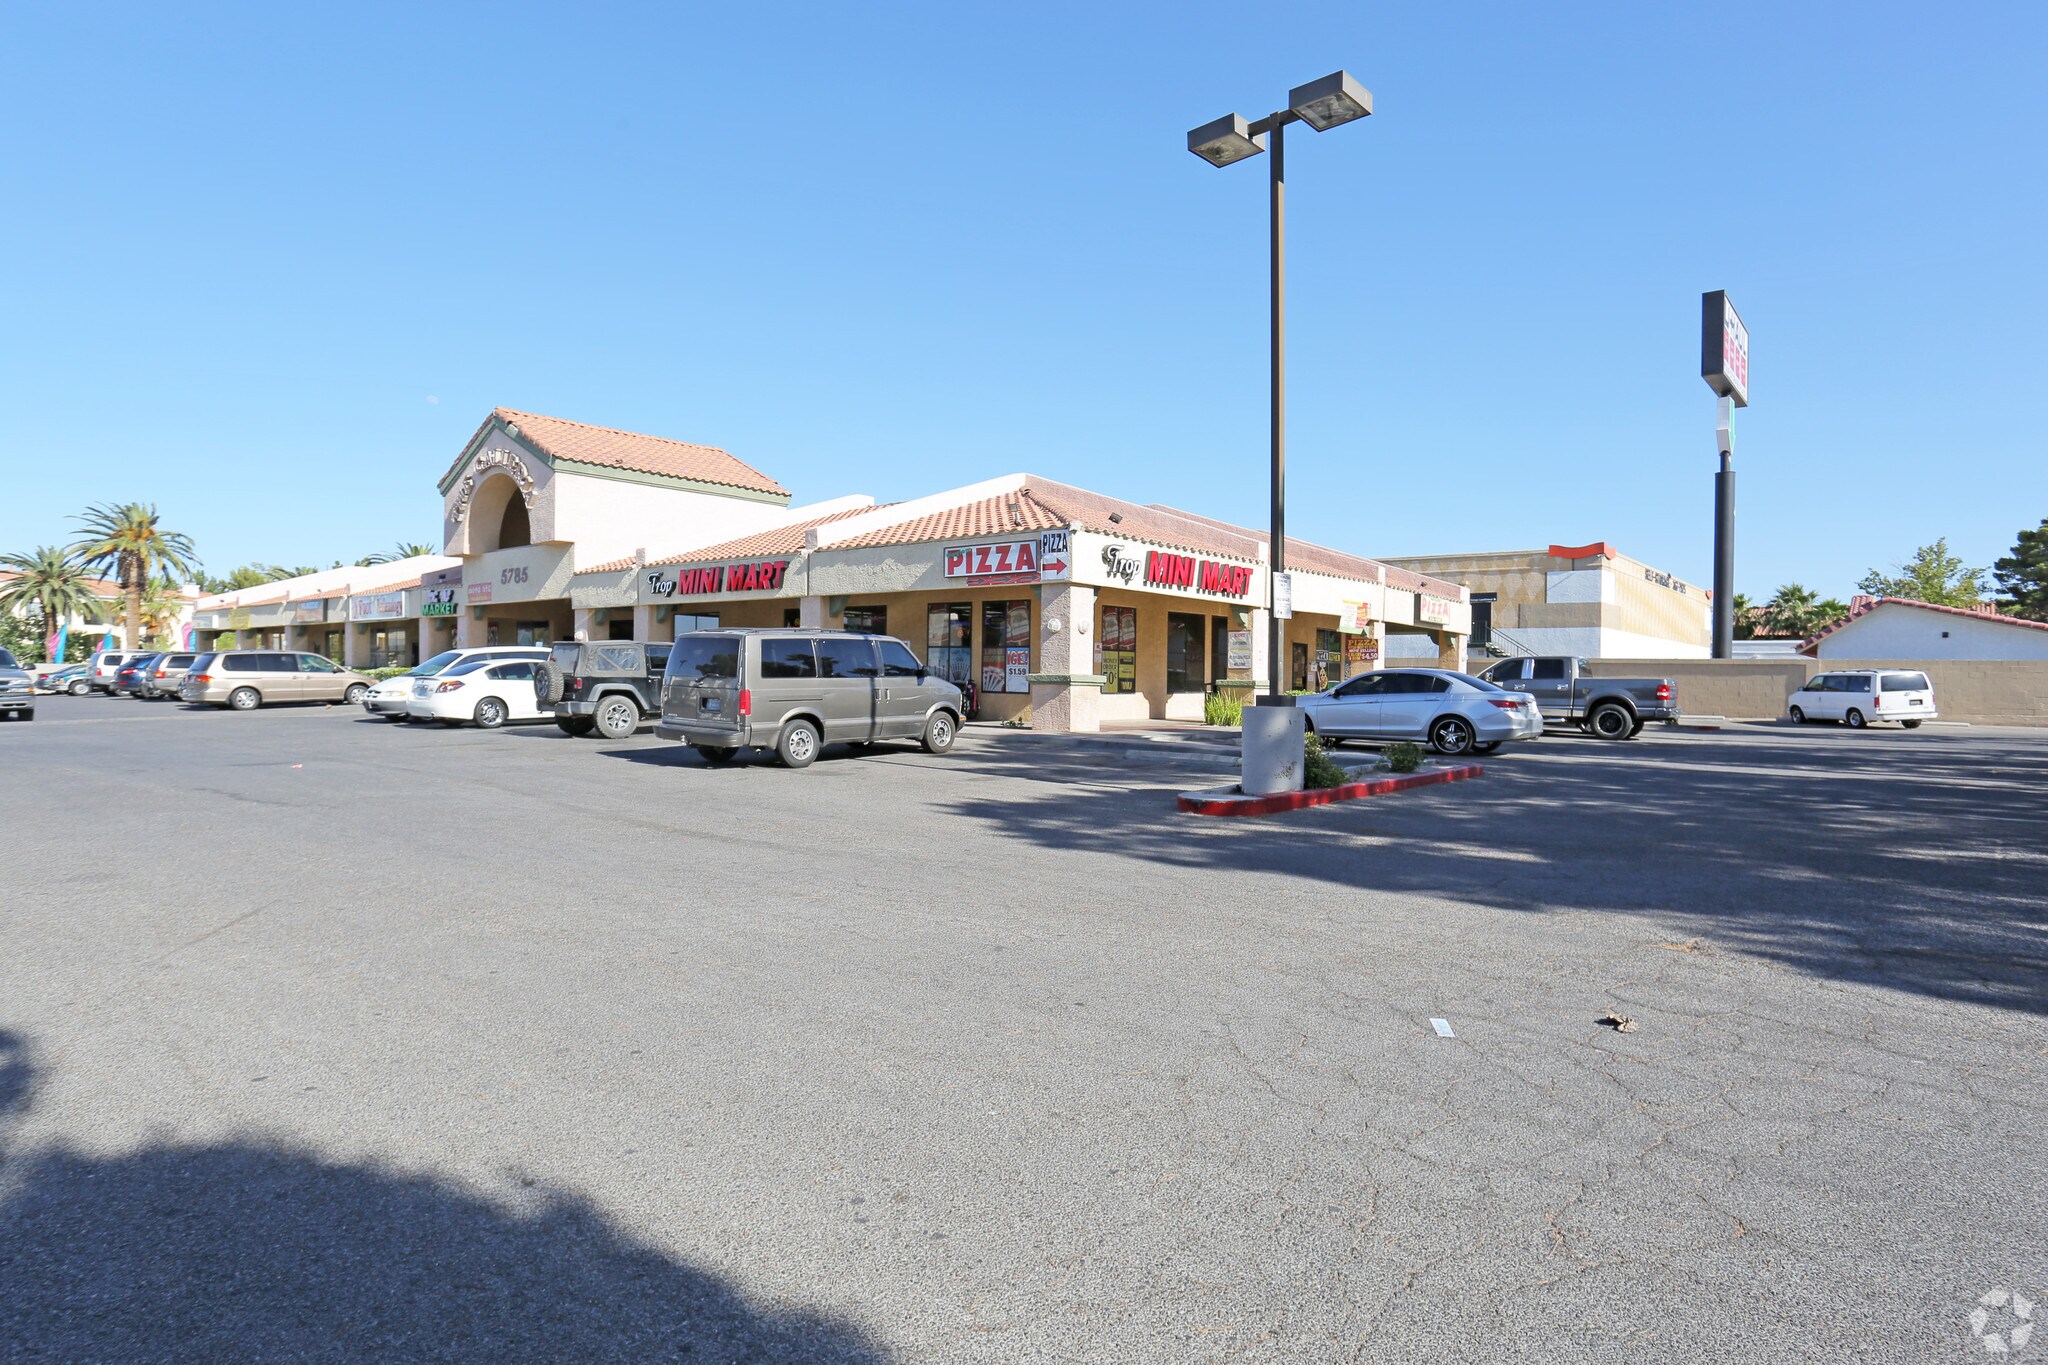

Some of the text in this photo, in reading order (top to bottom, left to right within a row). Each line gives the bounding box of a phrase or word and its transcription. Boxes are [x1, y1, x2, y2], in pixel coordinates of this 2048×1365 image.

[1042, 533, 1068, 554] PIZZA
[947, 543, 1036, 575] PIZZA
[500, 566, 529, 585] 5785
[647, 561, 787, 597] Trop MINI MART
[1105, 545, 1253, 596] Trop MINI MART
[422, 603, 456, 616] MARKET
[1421, 597, 1449, 617] PIZZA
[1007, 650, 1029, 665] ICE!
